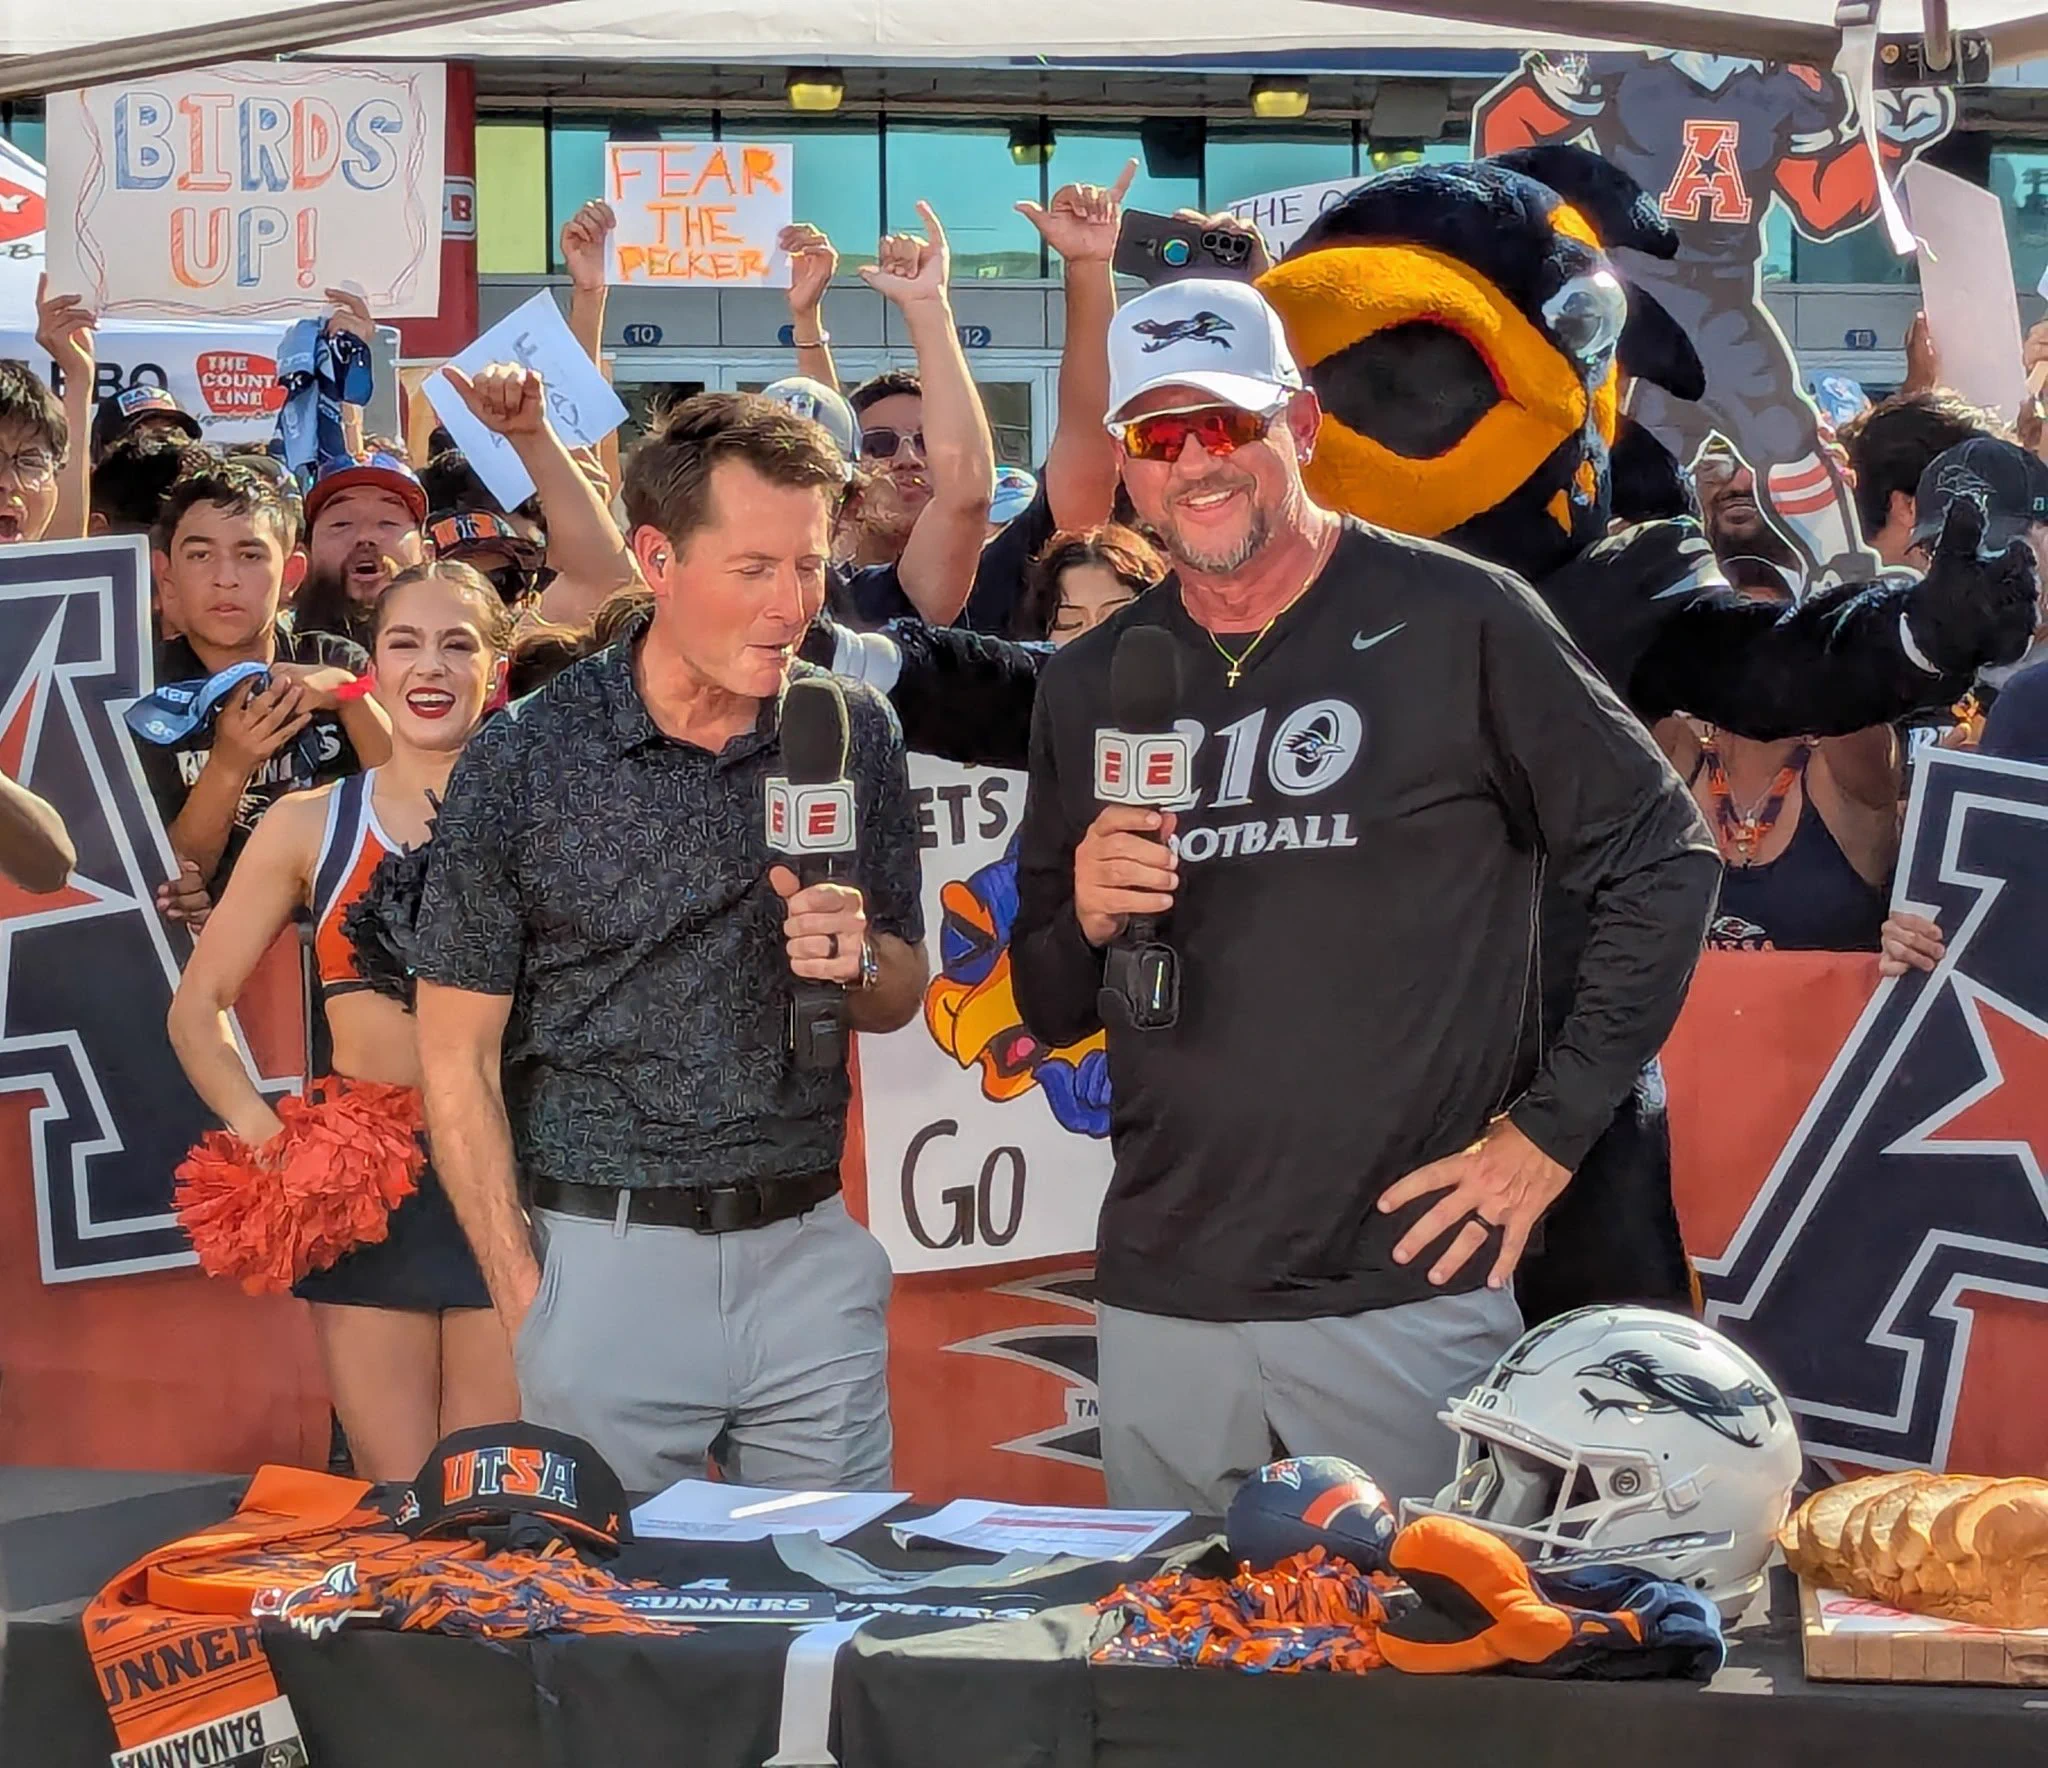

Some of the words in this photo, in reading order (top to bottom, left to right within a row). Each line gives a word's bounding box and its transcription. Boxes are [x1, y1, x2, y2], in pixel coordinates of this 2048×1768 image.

[113, 91, 404, 192] BIRDS
[611, 146, 784, 200] FEAR
[645, 202, 744, 247] THE
[1227, 193, 1303, 227] THE
[170, 205, 318, 288] UP!
[616, 246, 770, 281] PECKER
[630, 327, 654, 342] 10
[964, 328, 984, 346] 12
[202, 373, 279, 388] COUNT
[208, 356, 248, 371] THE
[213, 390, 263, 405] LINE
[901, 1118, 1026, 1249] GO
[443, 1446, 578, 1509] UTSA
